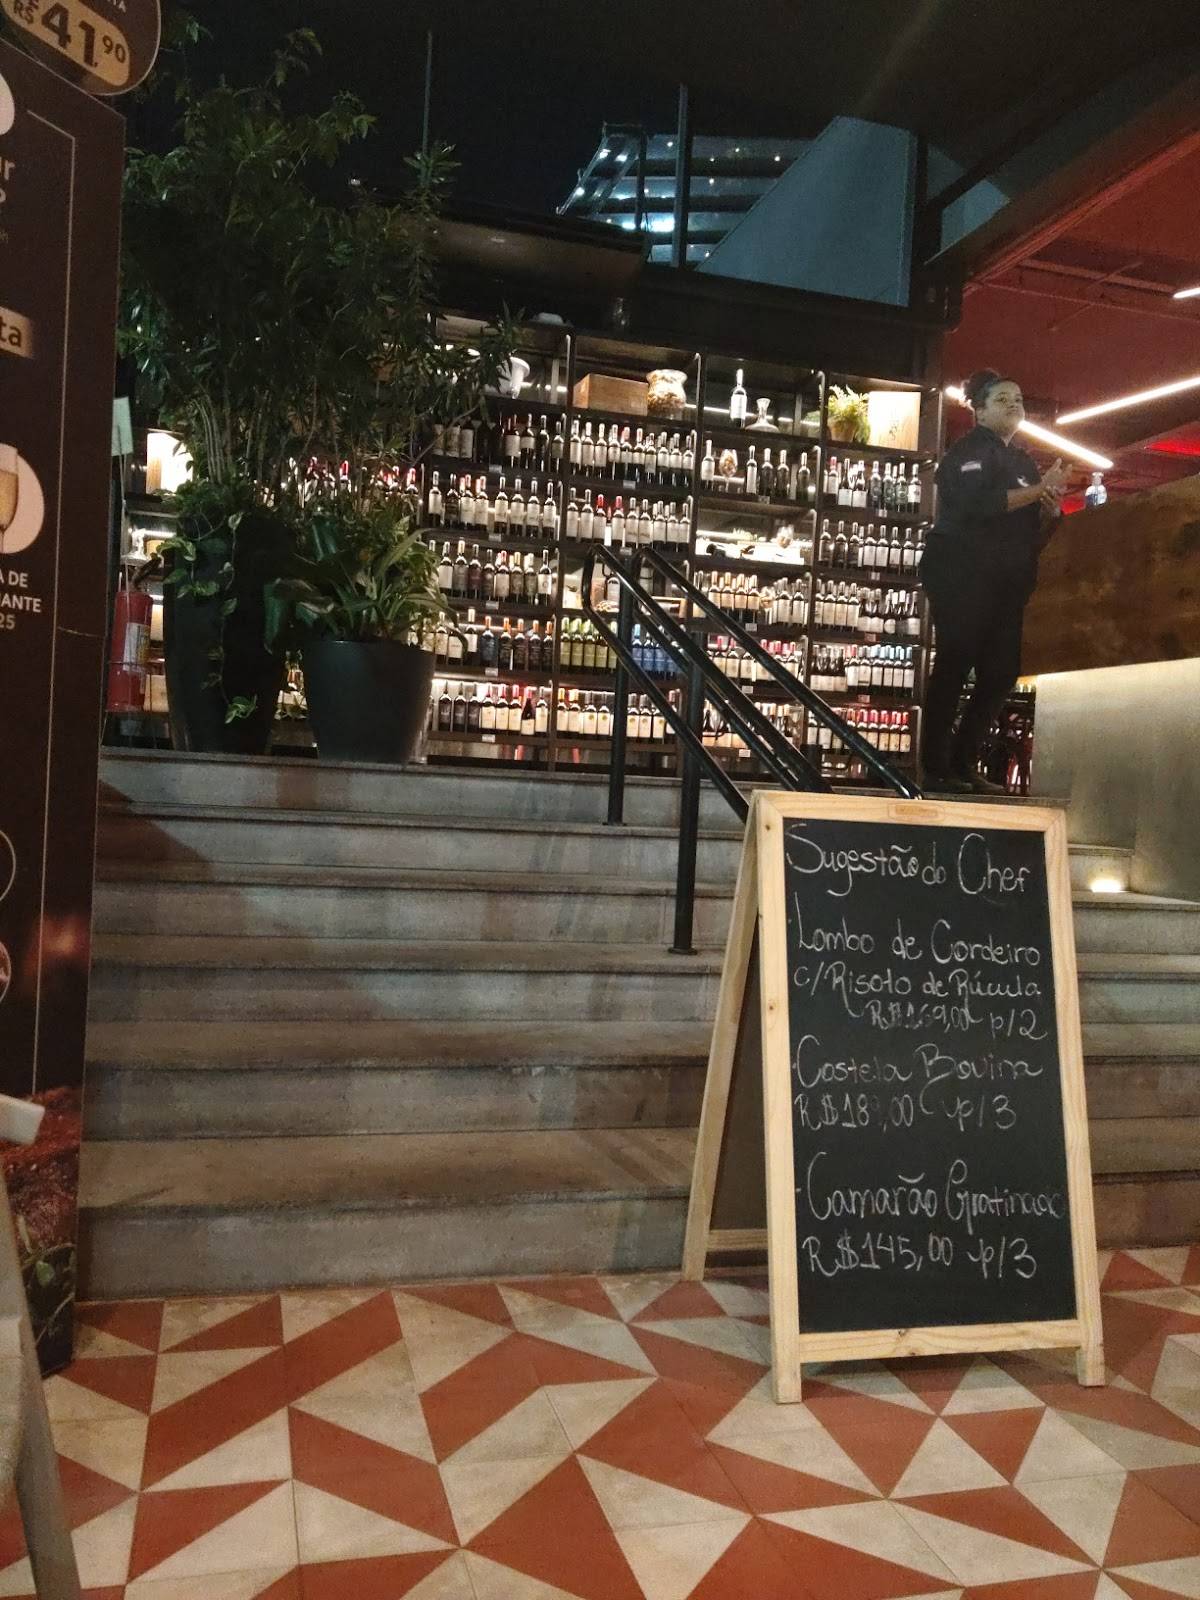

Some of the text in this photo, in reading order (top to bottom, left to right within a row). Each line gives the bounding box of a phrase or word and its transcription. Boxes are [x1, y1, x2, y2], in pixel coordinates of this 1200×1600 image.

[0, 592, 42, 613] ANTE
[8, 570, 28, 588] DE
[784, 823, 1034, 897] Sugestão do Chef
[795, 891, 1041, 967] Lombo de Cordeiro
[922, 971, 949, 998] de
[990, 1008, 1049, 1041] p/2
[796, 1034, 1044, 1112] Costela Bovina
[806, 1151, 939, 1220] Camarão
[801, 1229, 954, 1277] R$145,00
